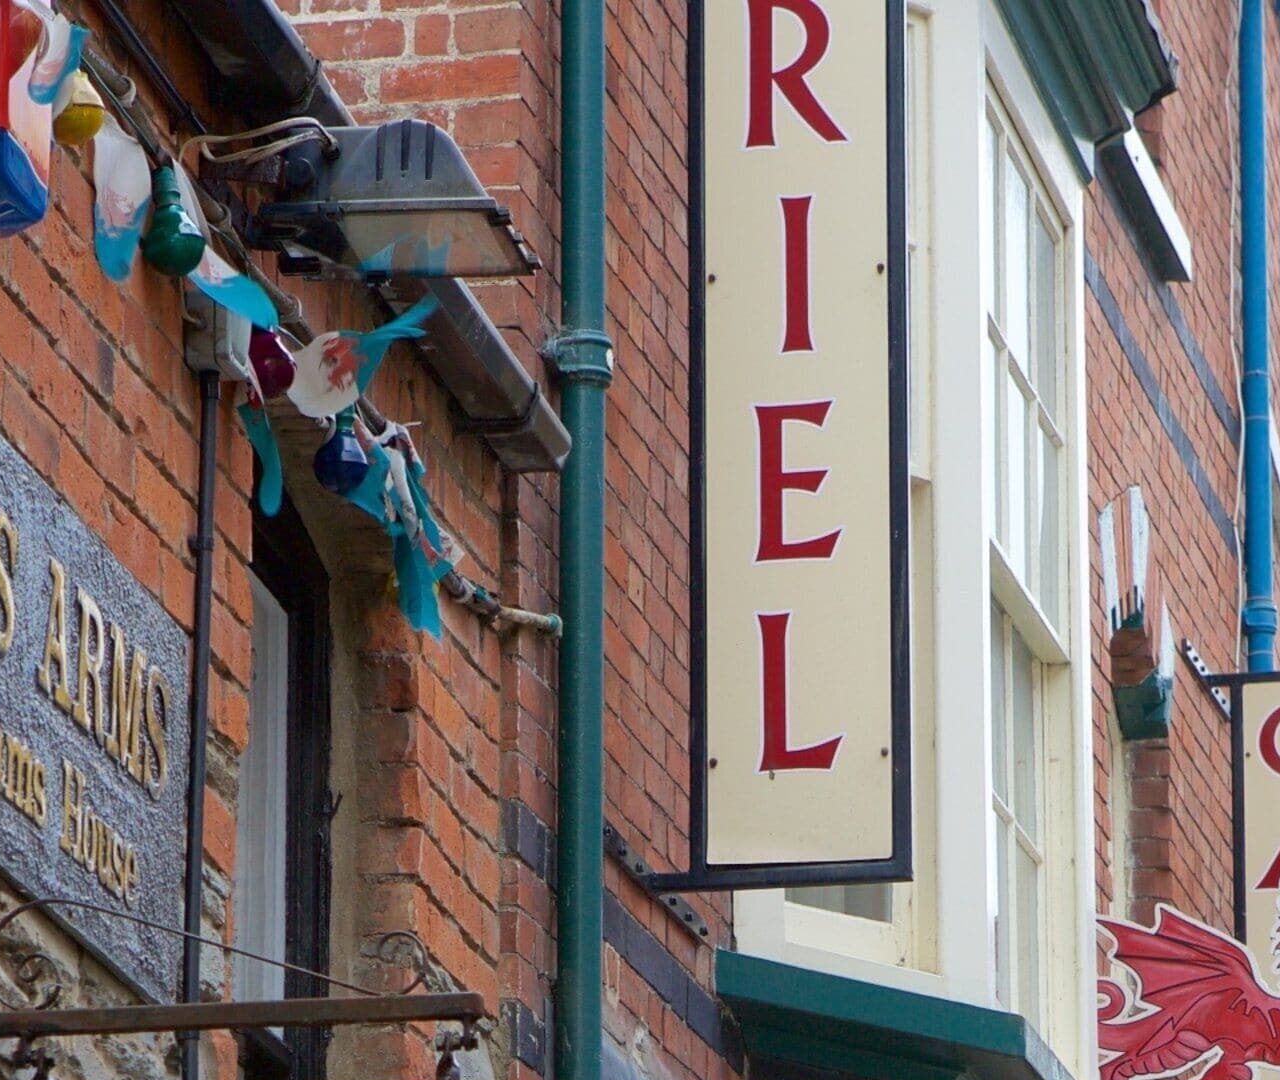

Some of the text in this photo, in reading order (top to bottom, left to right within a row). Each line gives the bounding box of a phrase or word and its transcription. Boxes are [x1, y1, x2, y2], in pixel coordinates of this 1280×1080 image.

[744, 0, 848, 773] RIEL
[37, 557, 170, 800] ARMS
[59, 757, 141, 908] House
